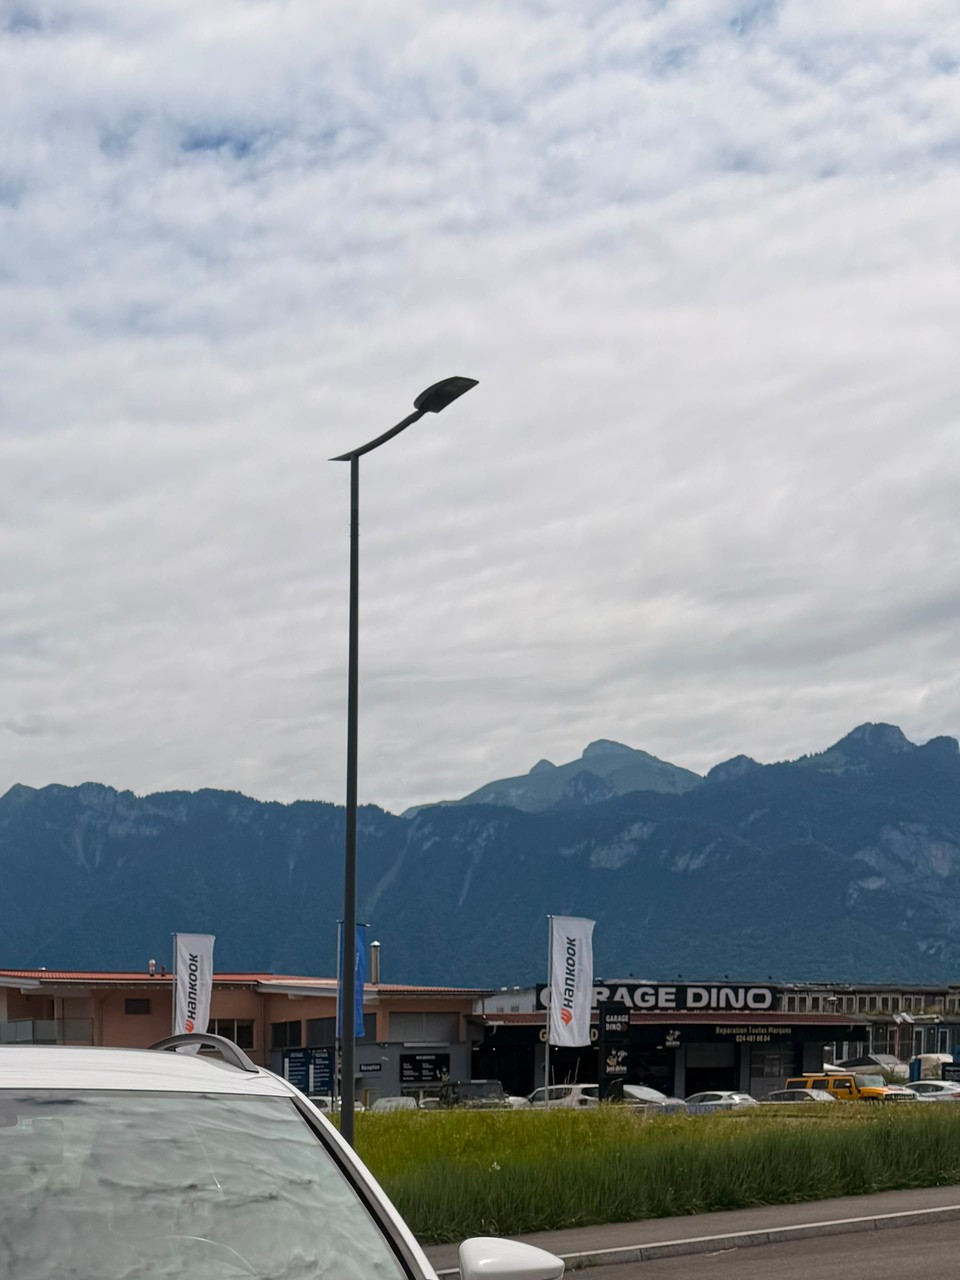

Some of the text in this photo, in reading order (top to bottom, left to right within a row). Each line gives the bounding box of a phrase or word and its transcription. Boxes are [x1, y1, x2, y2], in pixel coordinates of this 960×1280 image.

[686, 987, 772, 1009] DINO
[605, 1014, 629, 1022] GARAGE
[605, 1023, 621, 1031] DINO
